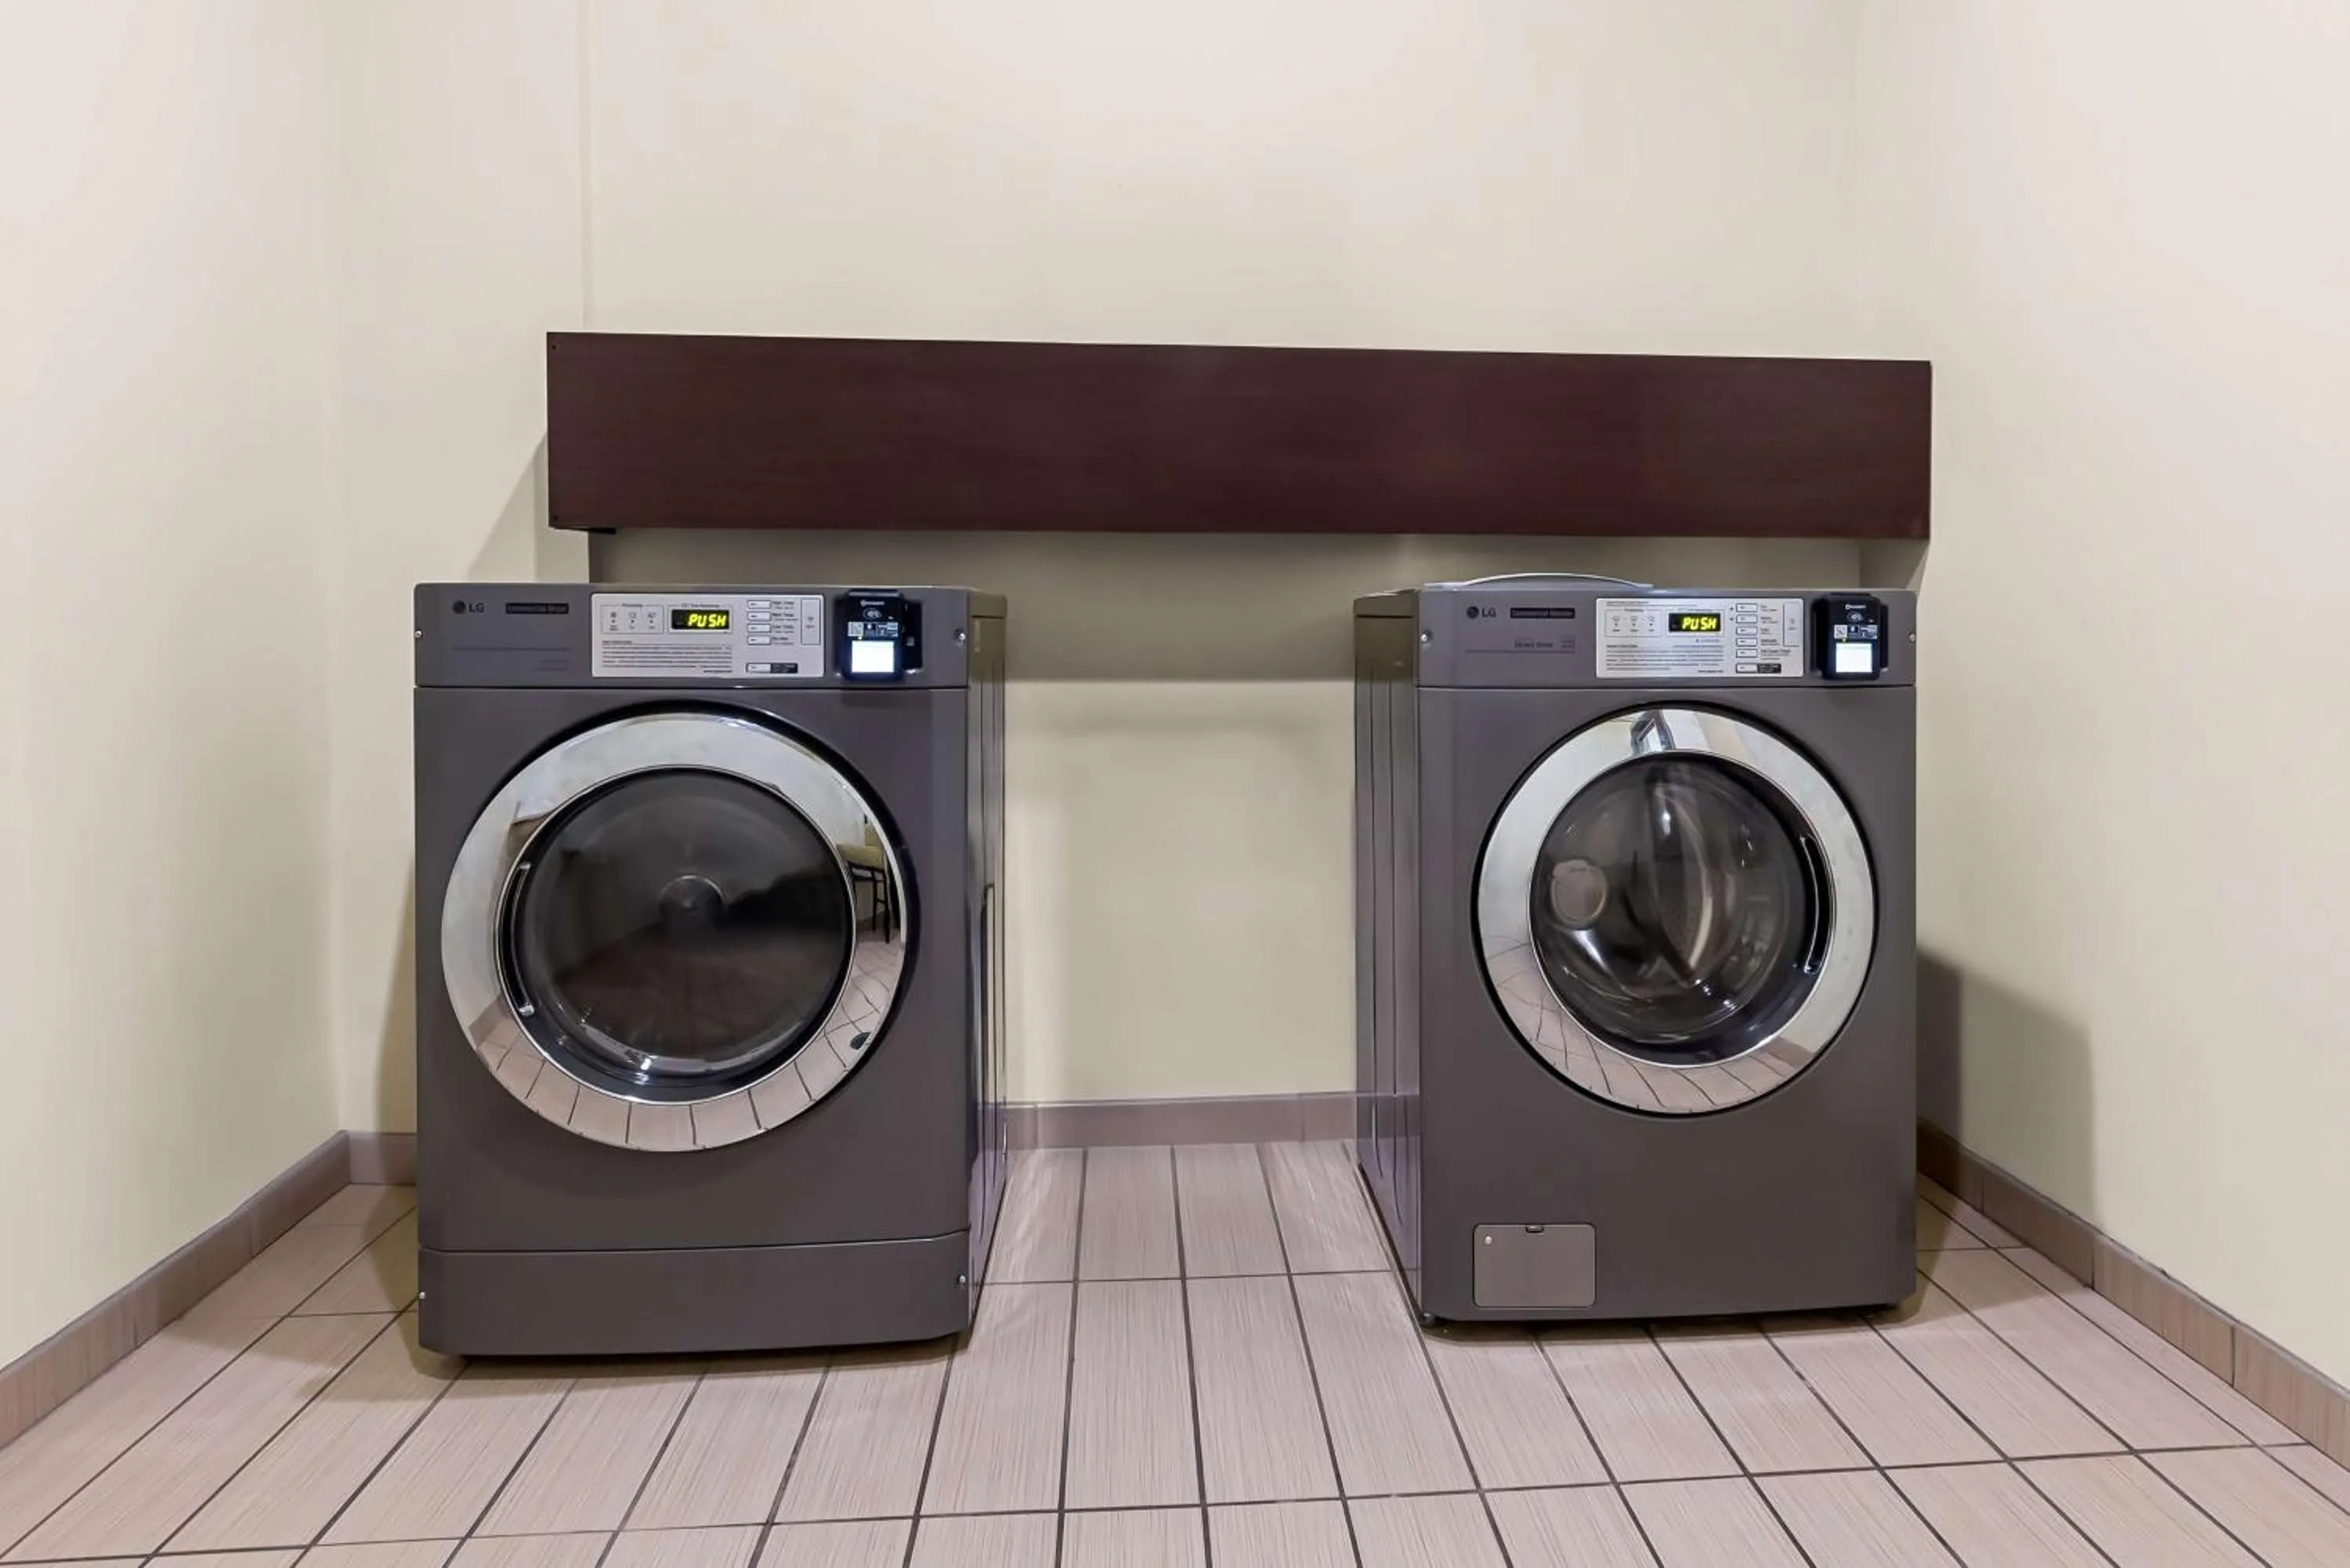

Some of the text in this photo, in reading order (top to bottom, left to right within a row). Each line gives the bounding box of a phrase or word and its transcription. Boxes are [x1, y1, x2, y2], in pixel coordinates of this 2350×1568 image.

[468, 602, 485, 613] LG
[1481, 607, 1497, 618] LG
[687, 613, 728, 627] PUSH
[1682, 616, 1718, 630] PUSH
